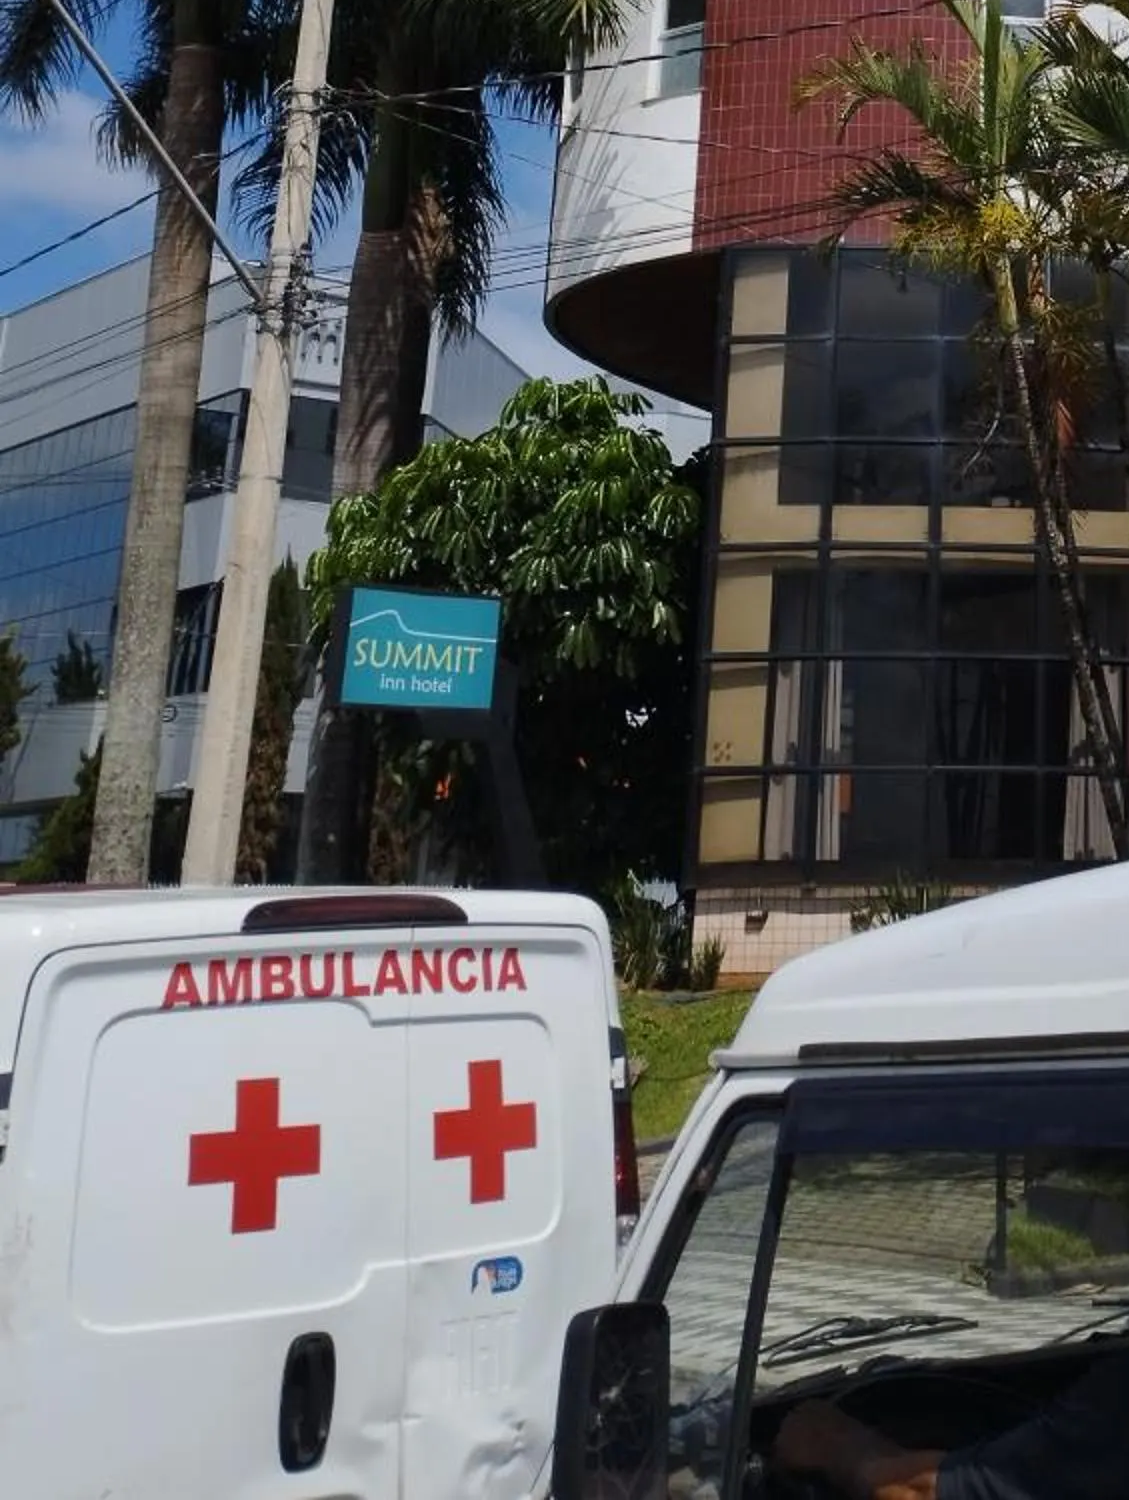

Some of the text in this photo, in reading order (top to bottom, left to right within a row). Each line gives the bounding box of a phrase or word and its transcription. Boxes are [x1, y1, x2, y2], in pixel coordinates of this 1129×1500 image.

[352, 637, 484, 675] SUMMIT
[379, 673, 453, 694] inn hotel
[160, 946, 528, 1010] AMBULANCIA
